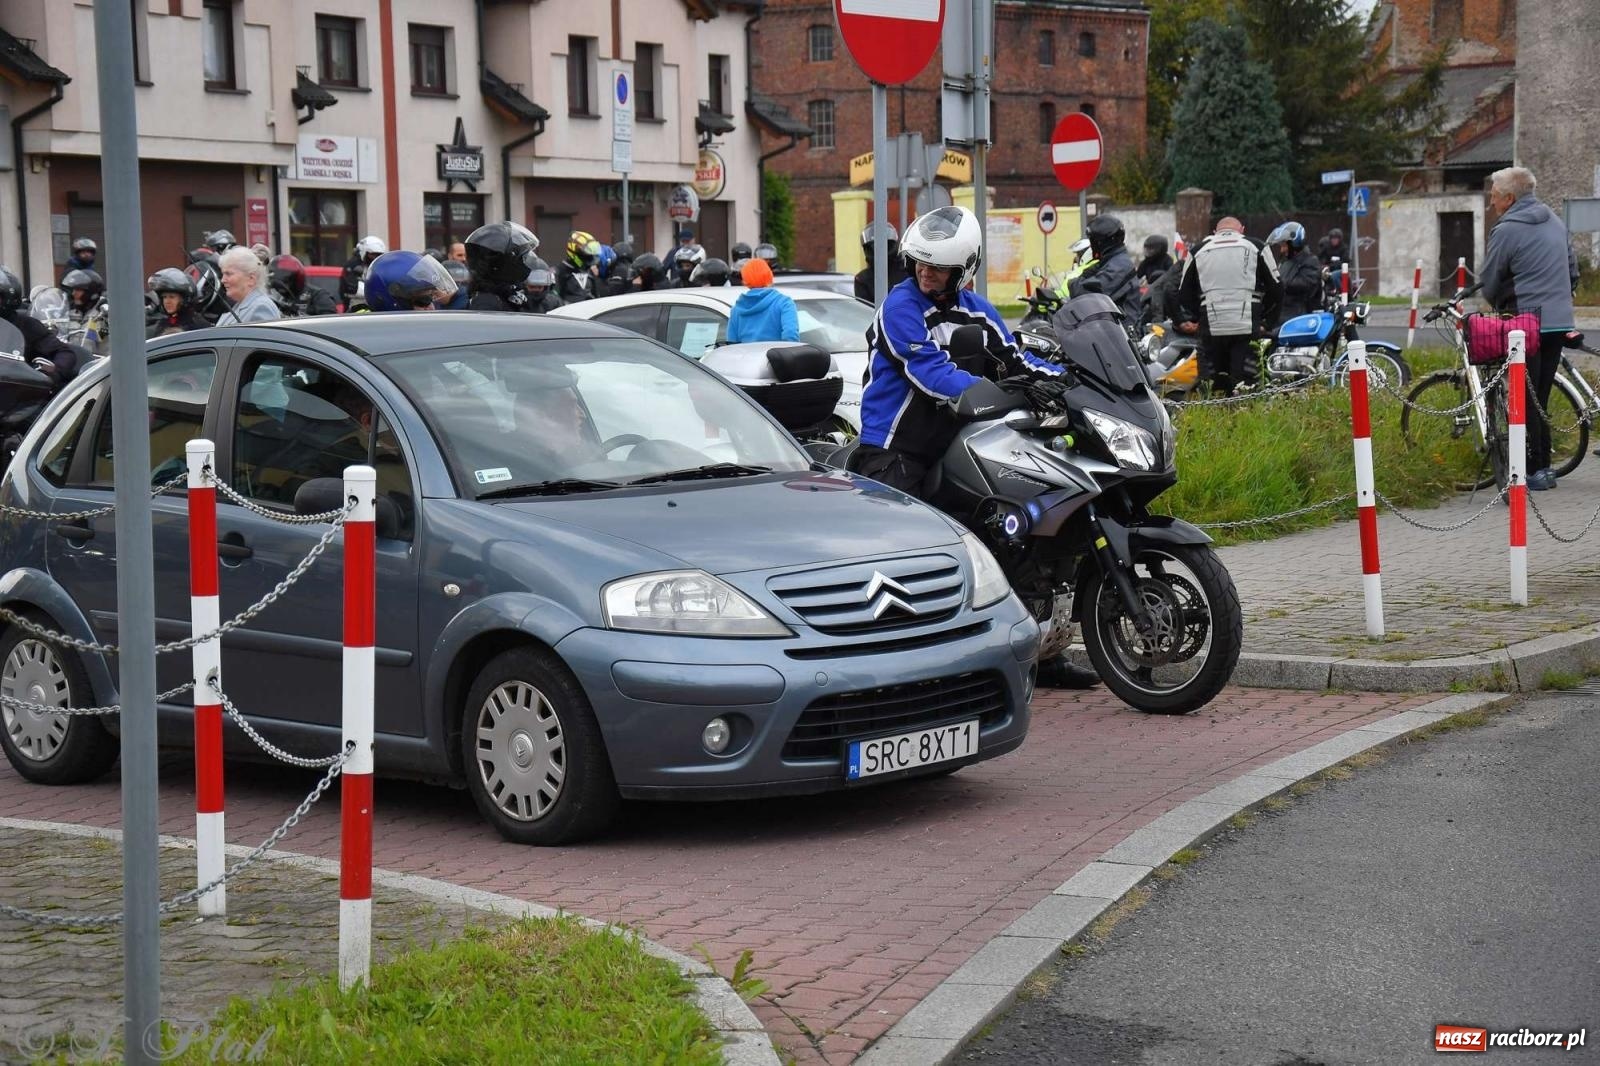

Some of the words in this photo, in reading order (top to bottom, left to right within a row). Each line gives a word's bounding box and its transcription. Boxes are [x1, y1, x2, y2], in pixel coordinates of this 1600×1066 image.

[865, 737, 910, 773] SRC
[918, 724, 971, 763] 8XT1
[849, 765, 859, 774] PL
